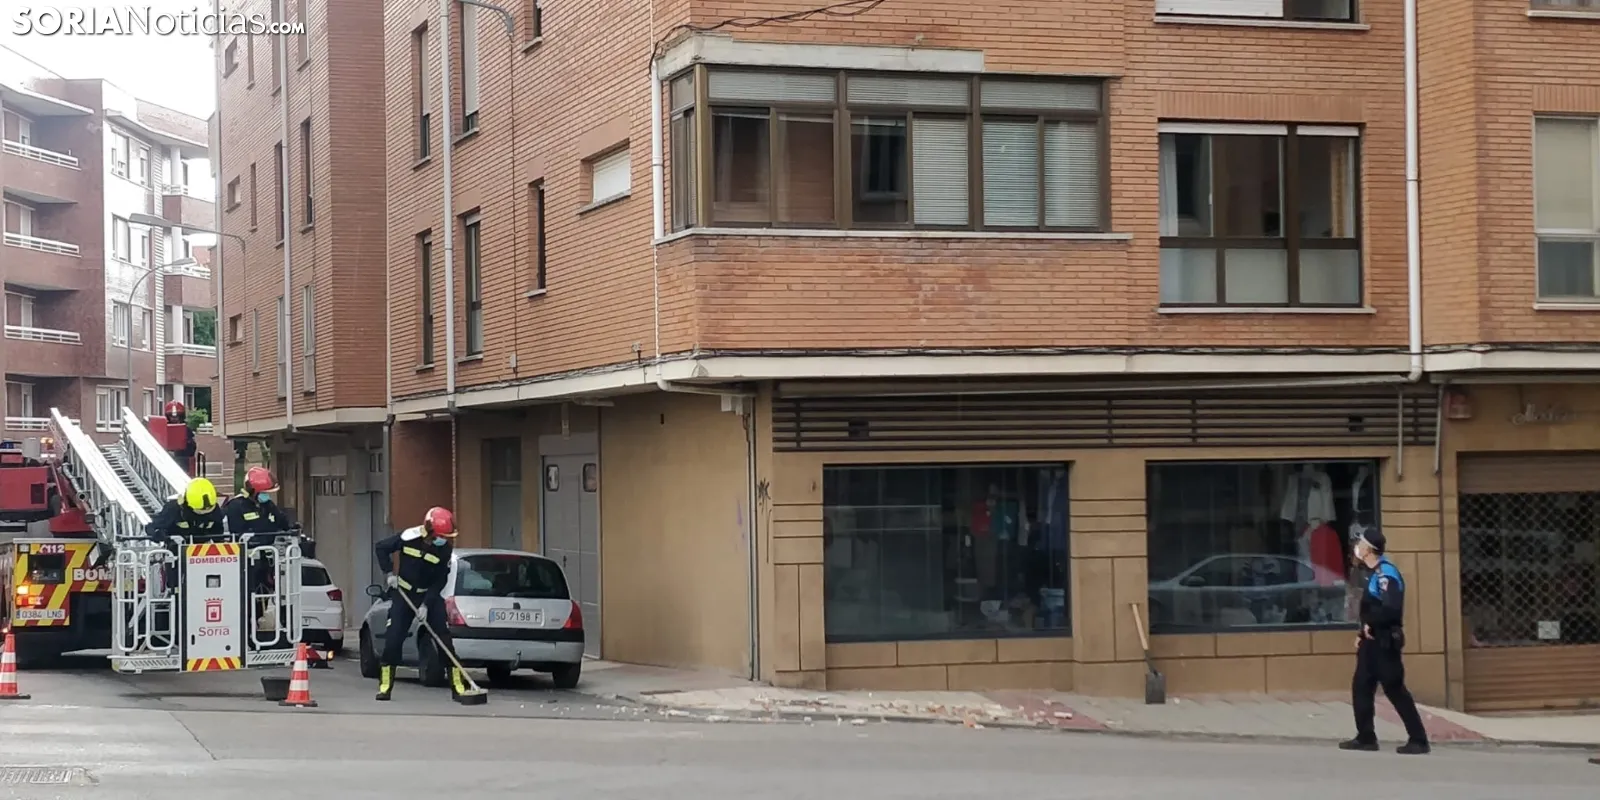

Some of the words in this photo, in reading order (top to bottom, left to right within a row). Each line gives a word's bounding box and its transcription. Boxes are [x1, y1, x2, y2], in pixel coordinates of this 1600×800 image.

[189, 556, 238, 564] BOMBEROS
[509, 612, 531, 621] 7198
[198, 626, 230, 636] Soria
